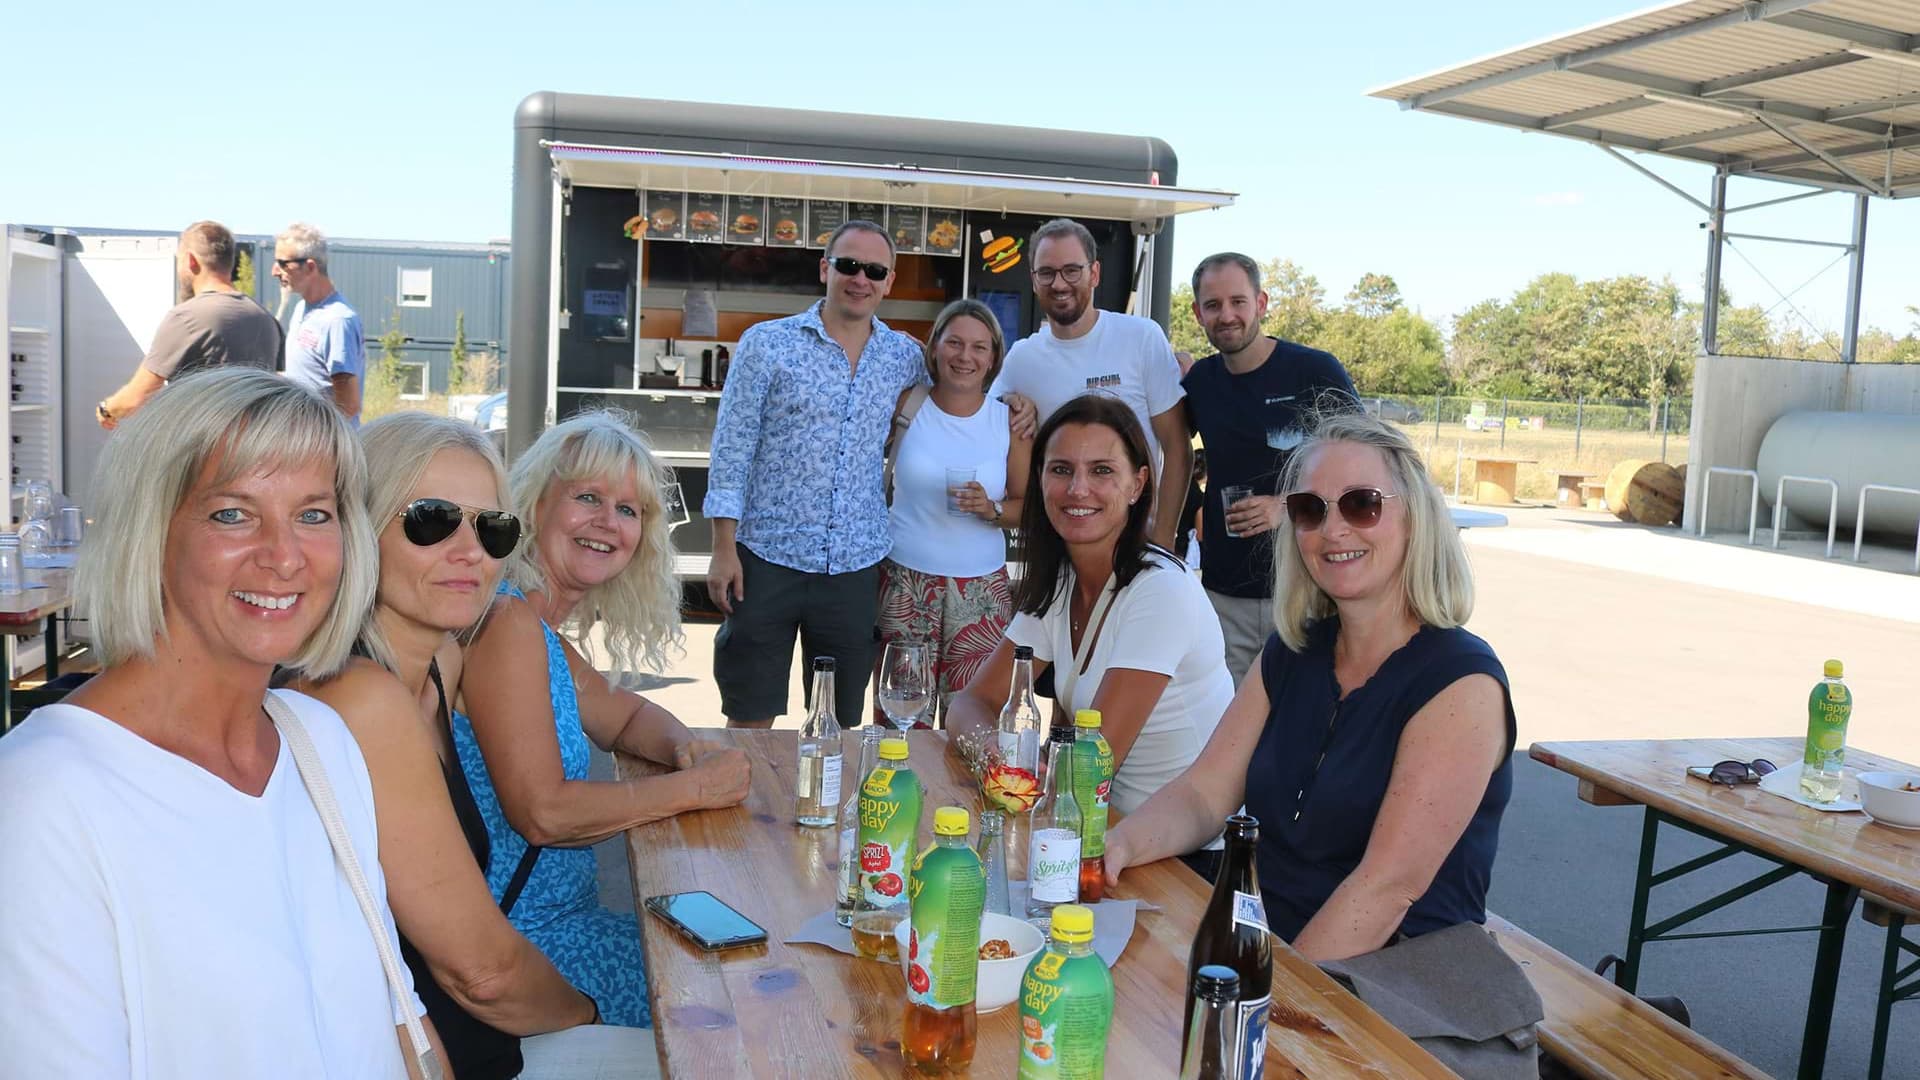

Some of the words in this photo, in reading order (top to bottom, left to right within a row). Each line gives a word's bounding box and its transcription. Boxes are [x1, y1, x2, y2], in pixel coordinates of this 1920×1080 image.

[1824, 713, 1843, 724] day
[861, 813, 888, 833] day
[1025, 993, 1050, 1016] day
